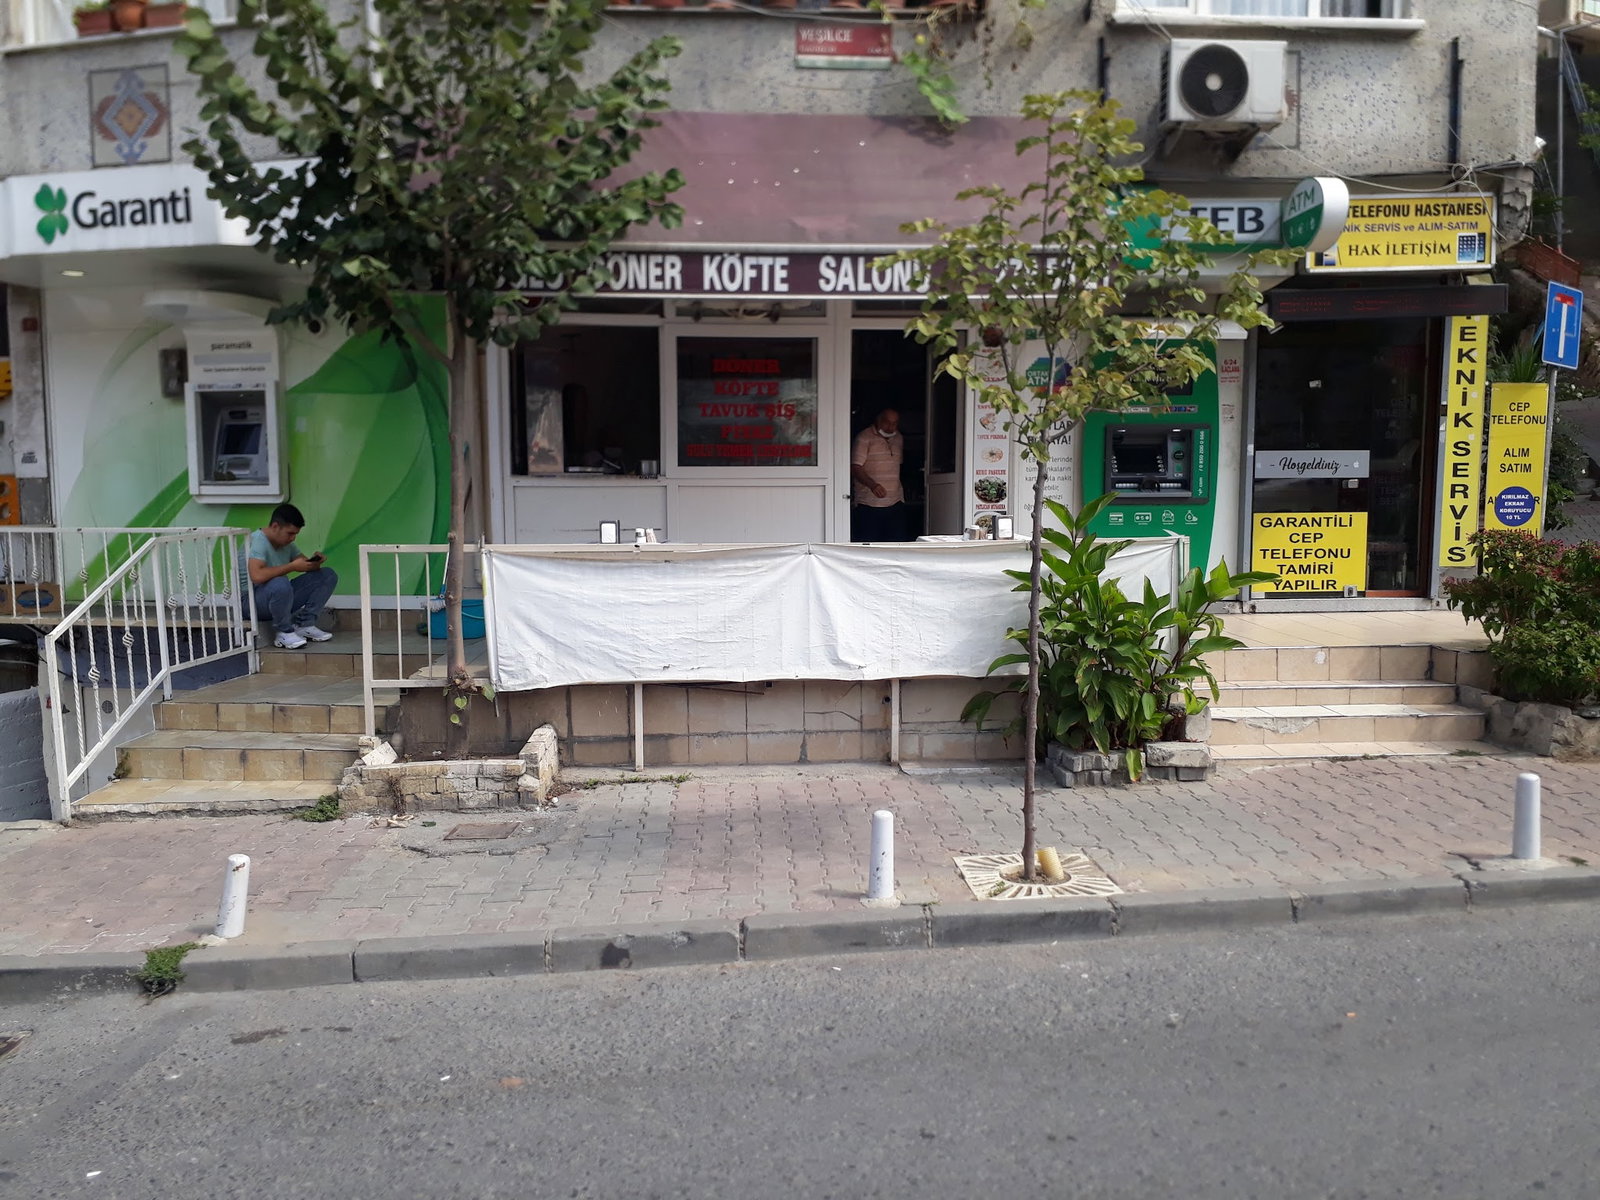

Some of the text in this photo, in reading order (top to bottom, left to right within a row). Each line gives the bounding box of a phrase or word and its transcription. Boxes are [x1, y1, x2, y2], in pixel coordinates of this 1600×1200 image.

[1288, 186, 1315, 215] ATM
[72, 187, 192, 229] Garanti
[1364, 221, 1401, 232] SERVİS
[1418, 221, 1479, 231] ALIM-SATIM
[1348, 240, 1452, 256] HAK İLETİŞİM
[702, 252, 790, 292] KÖFTE
[1454, 315, 1478, 428] EKNİK
[714, 379, 779, 395] KÖFTE
[1027, 377, 1049, 386] ATM
[698, 400, 796, 421] TAVUK ŞİŞ
[1509, 402, 1530, 412] CEP
[1492, 415, 1547, 425] TELEFONU
[1503, 448, 1530, 457] ALIM
[1499, 463, 1532, 473] SATIM
[1447, 440, 1472, 562] SERVİS
[1260, 514, 1353, 528] GARANTİLİ
[1289, 532, 1324, 543] CEP
[1259, 548, 1351, 559] TELEFONU
[1276, 562, 1334, 575] TAMİRİ
[1273, 579, 1337, 590] YAPILIR
